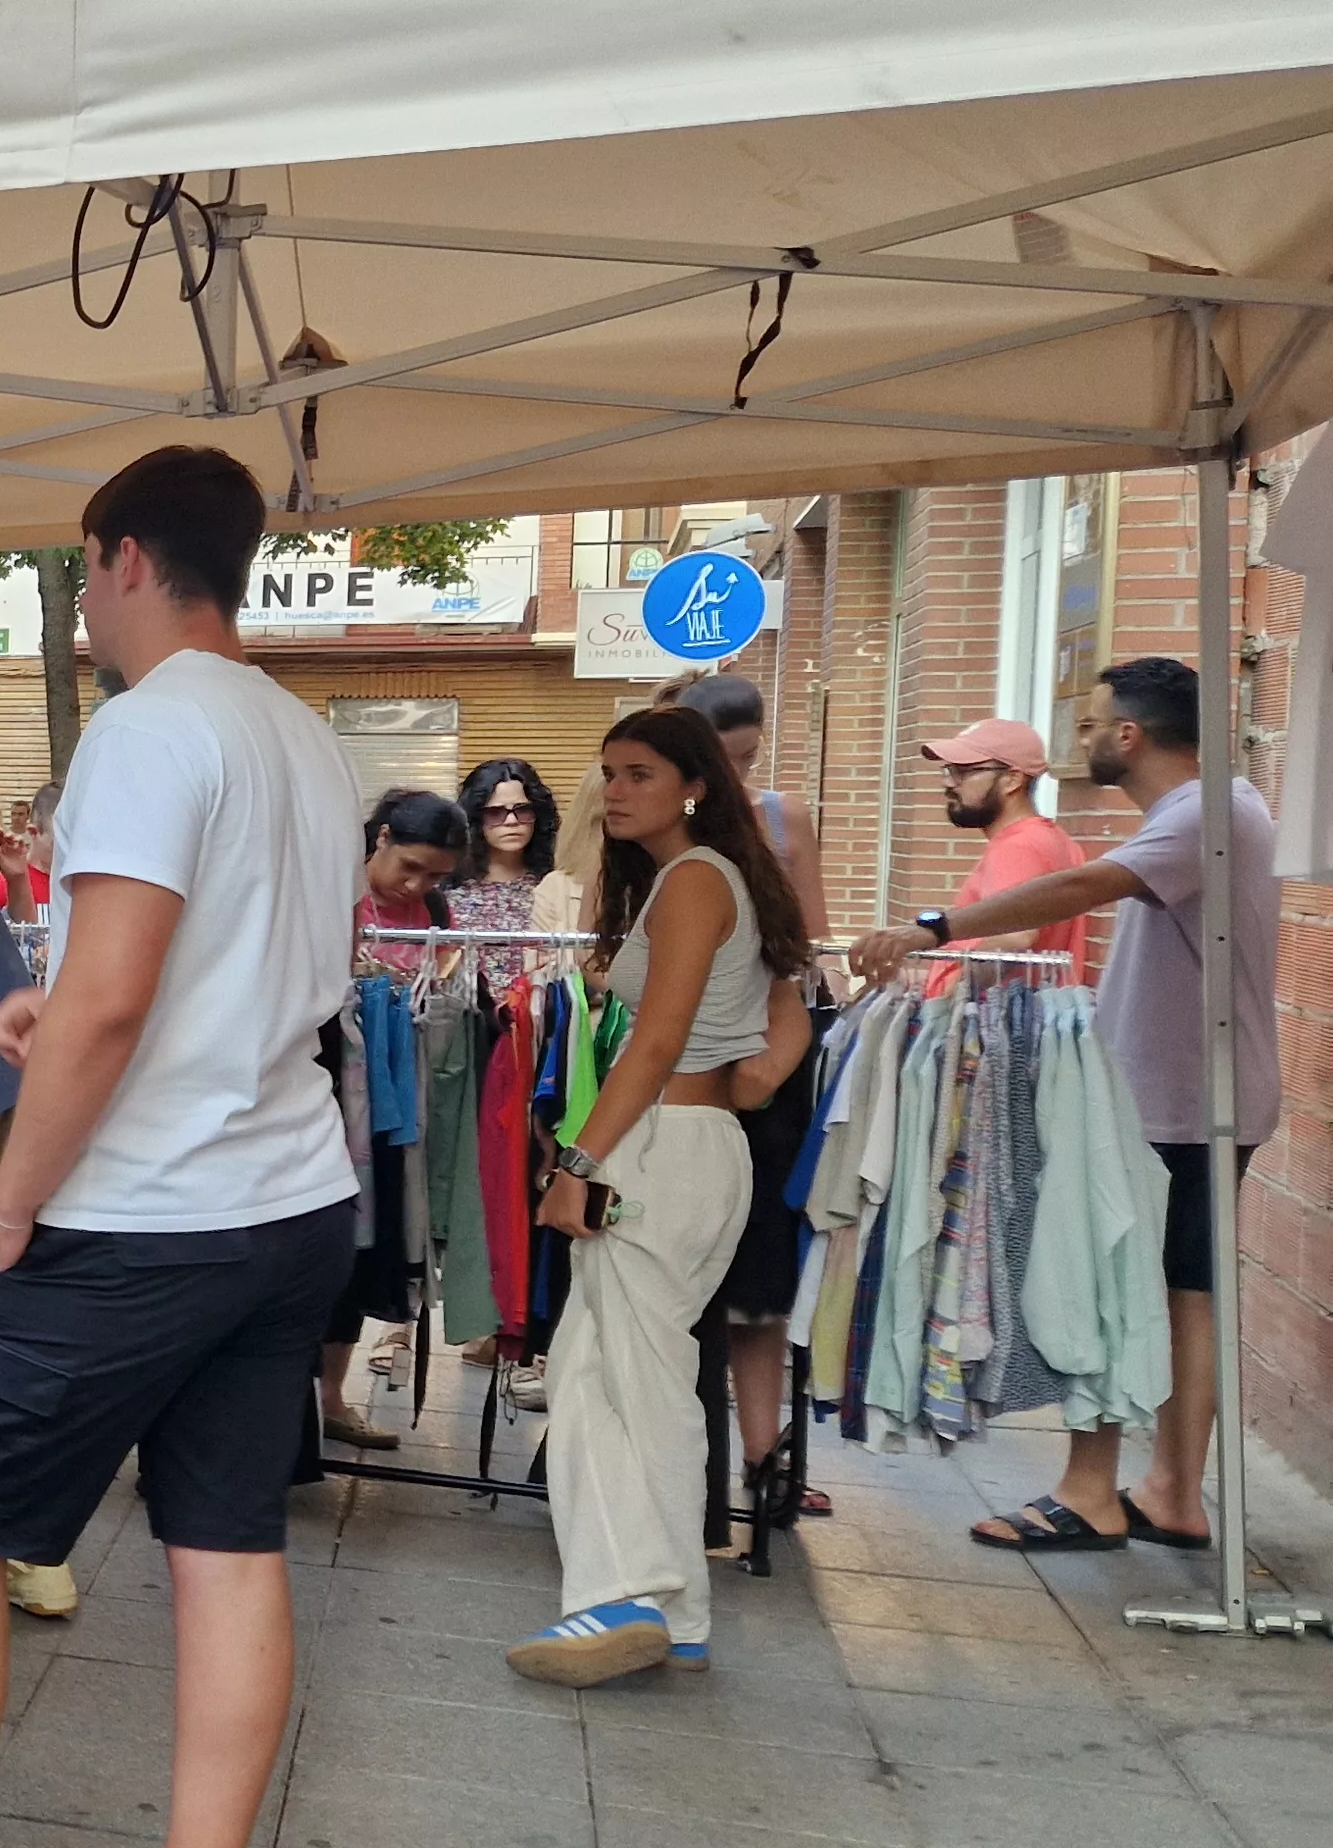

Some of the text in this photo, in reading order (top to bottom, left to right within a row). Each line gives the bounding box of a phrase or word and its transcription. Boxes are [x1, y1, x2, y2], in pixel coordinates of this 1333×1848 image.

[240, 571, 375, 609] NPE
[432, 597, 481, 610] ANPE
[285, 610, 375, 622] huesca@anpe.es
[588, 649, 670, 659] INMOBILI
